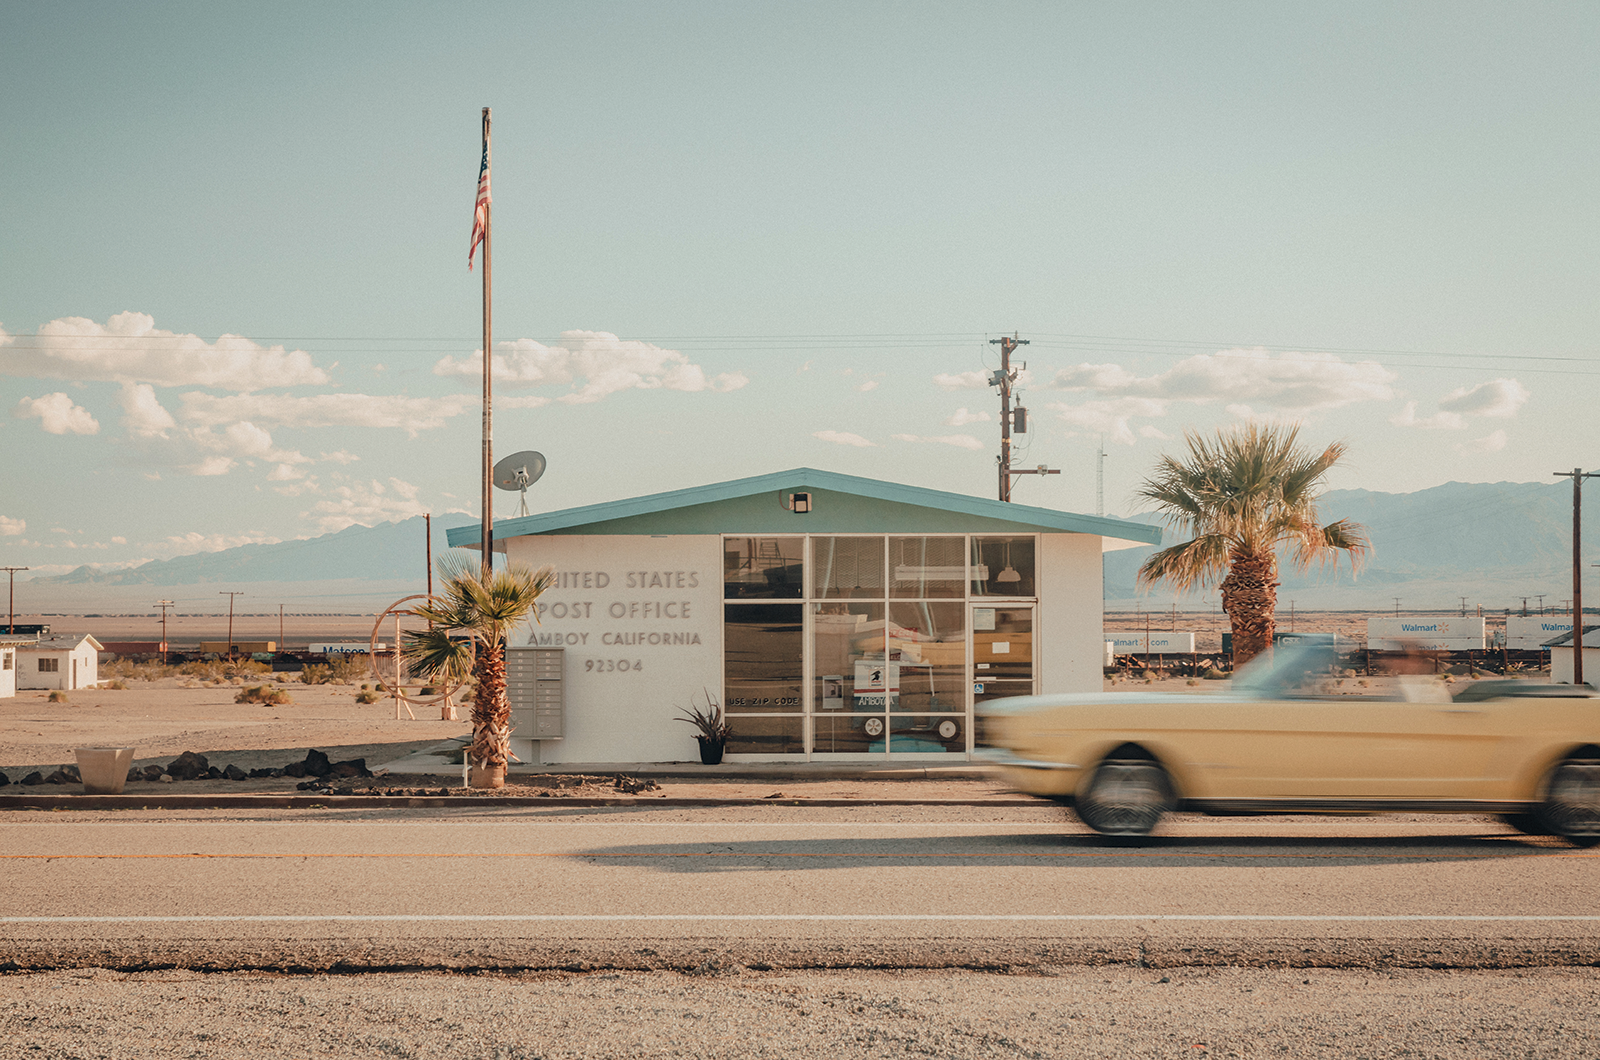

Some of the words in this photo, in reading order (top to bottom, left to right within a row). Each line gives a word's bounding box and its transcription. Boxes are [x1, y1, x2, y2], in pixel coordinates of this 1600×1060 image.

[551, 571, 611, 589] ITED
[626, 571, 699, 589] STATES
[538, 601, 593, 619] POST
[609, 601, 691, 619] OFFICE
[1541, 623, 1574, 631] Walmar
[527, 632, 589, 646] AMBOY
[601, 632, 702, 646] CALIFORNIA
[585, 659, 643, 672] 92304
[729, 698, 746, 706] USE
[752, 698, 770, 706] ZIP
[774, 698, 799, 706] CODE
